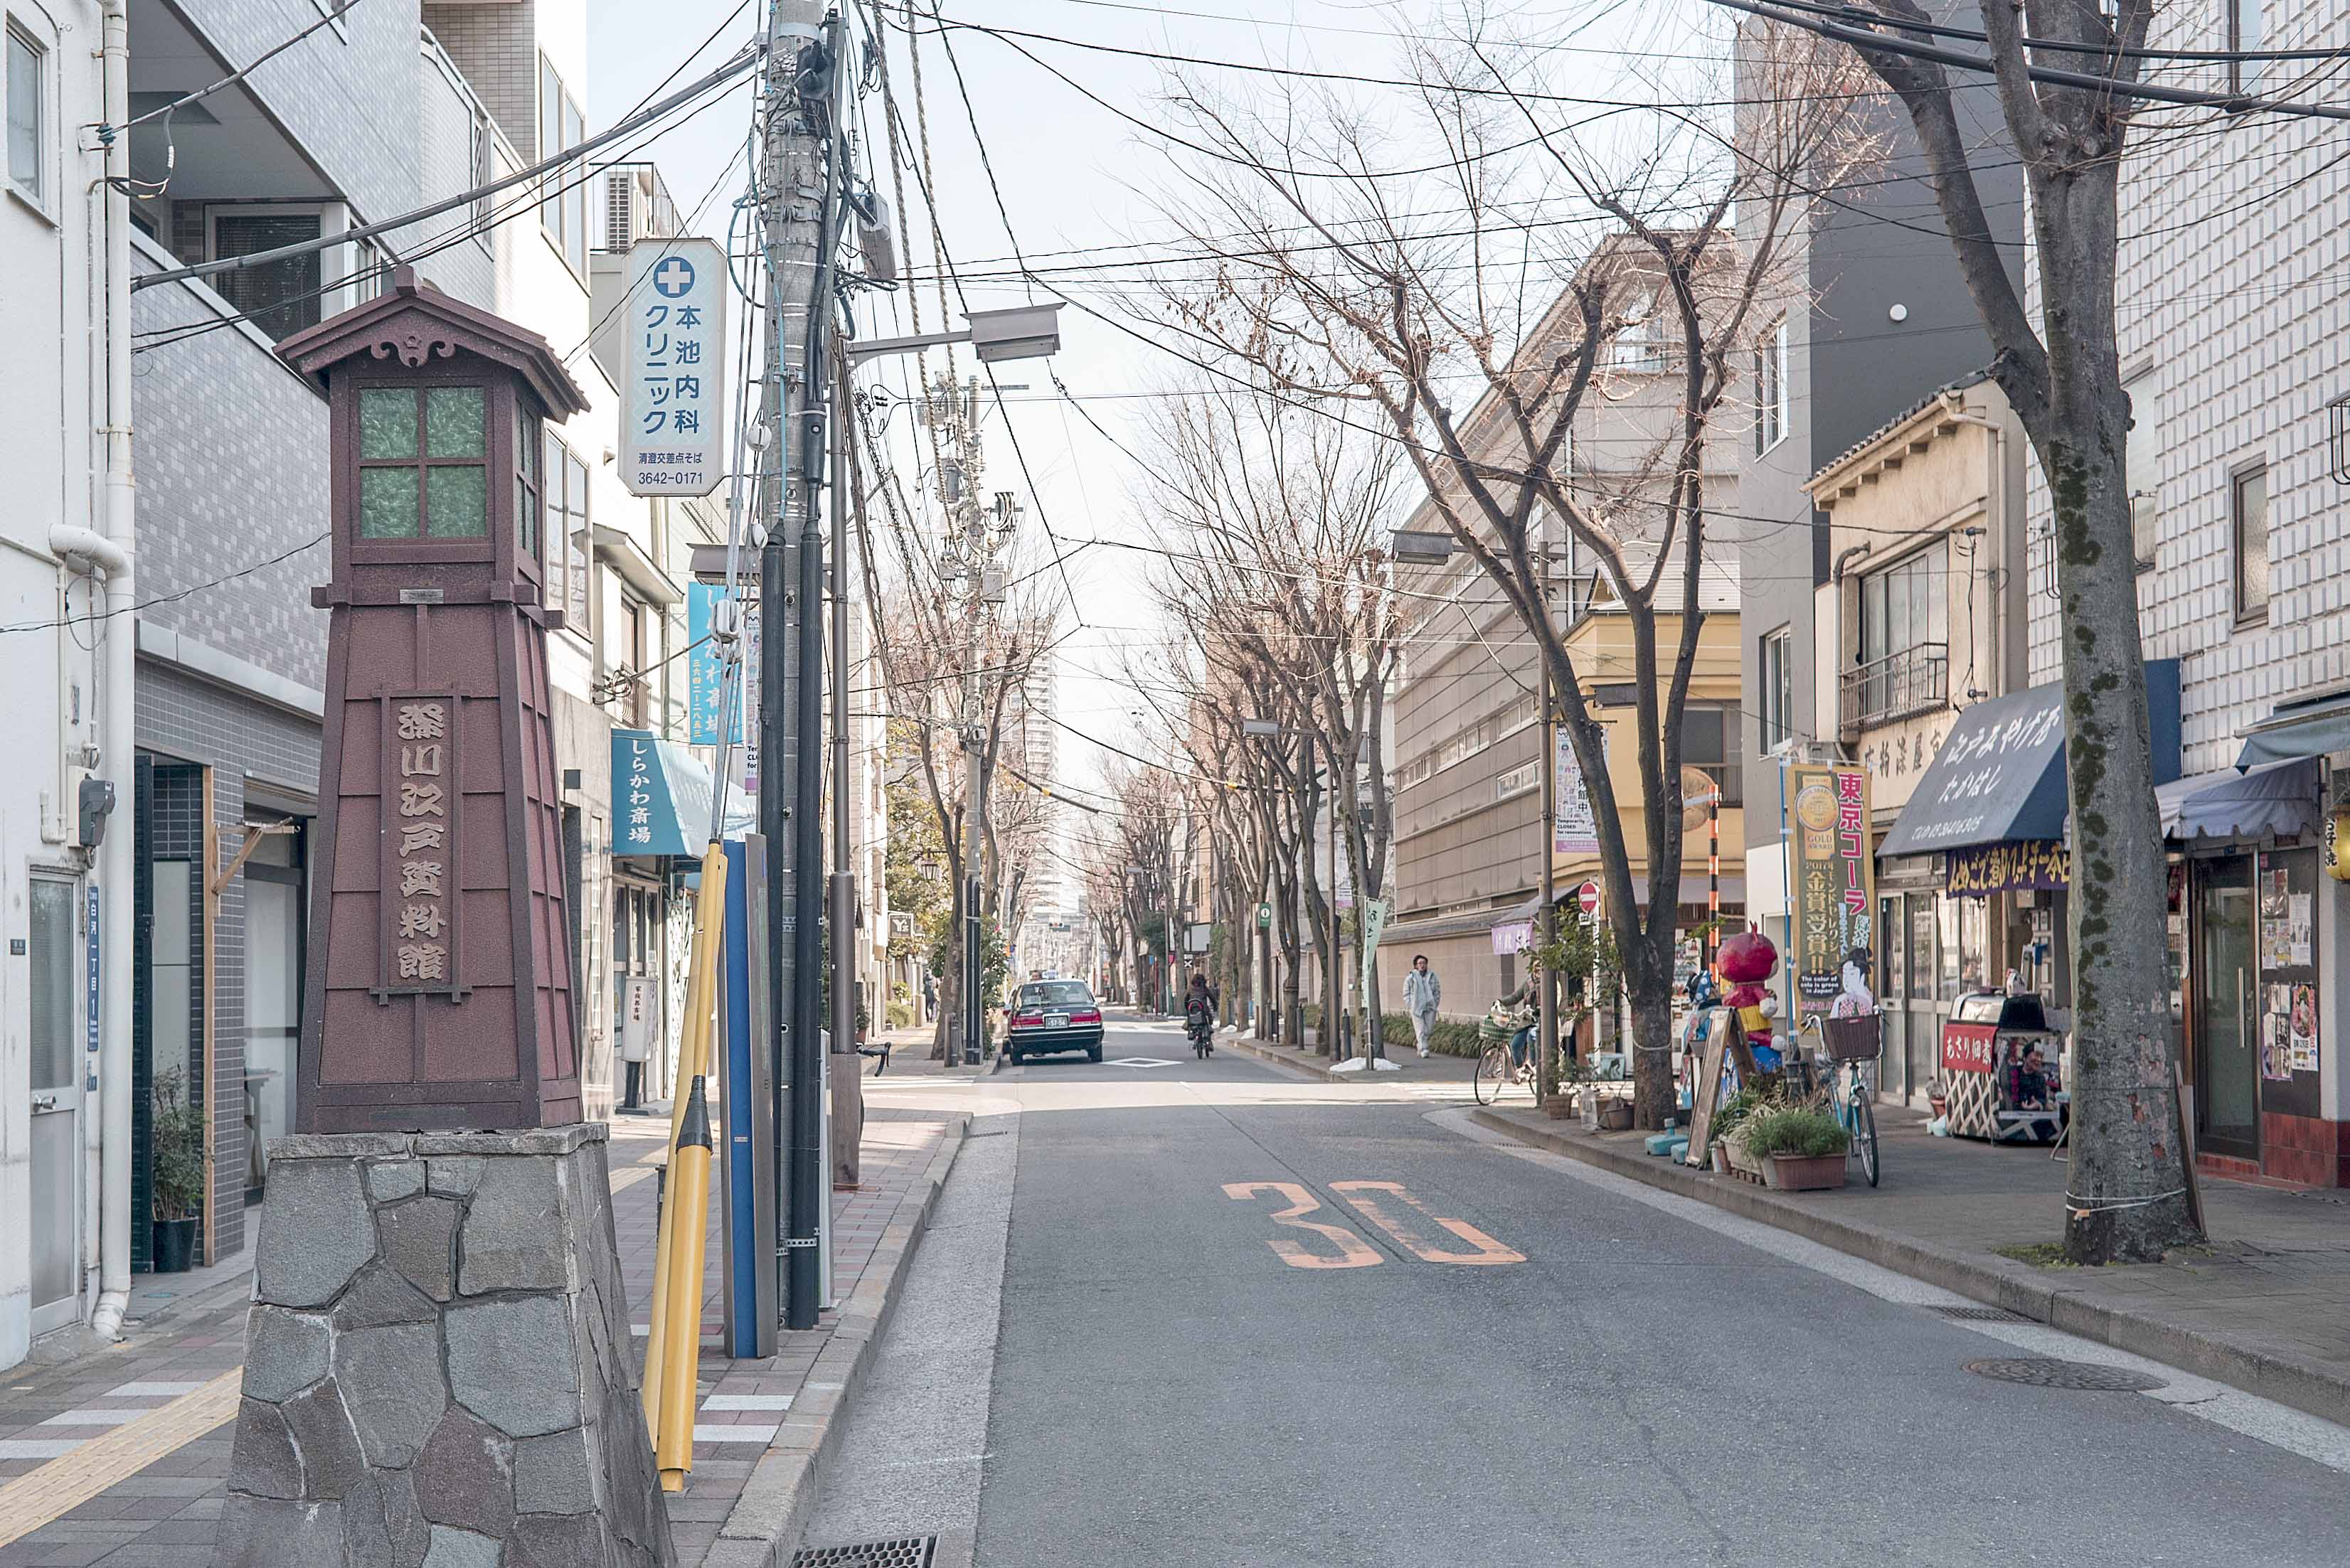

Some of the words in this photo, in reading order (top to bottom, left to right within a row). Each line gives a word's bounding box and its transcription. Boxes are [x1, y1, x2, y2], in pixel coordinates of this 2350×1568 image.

[643, 305, 670, 434] クリニック
[676, 306, 701, 434] 本池内科
[638, 472, 703, 485] 3642-0171
[639, 452, 703, 464] 清澄交差点そば
[628, 740, 652, 843] しらかわ斎場
[1837, 772, 1867, 916] 東京コーラ
[1946, 1035, 1992, 1065] あさり佃煮
[1221, 1180, 1527, 1269] 30
